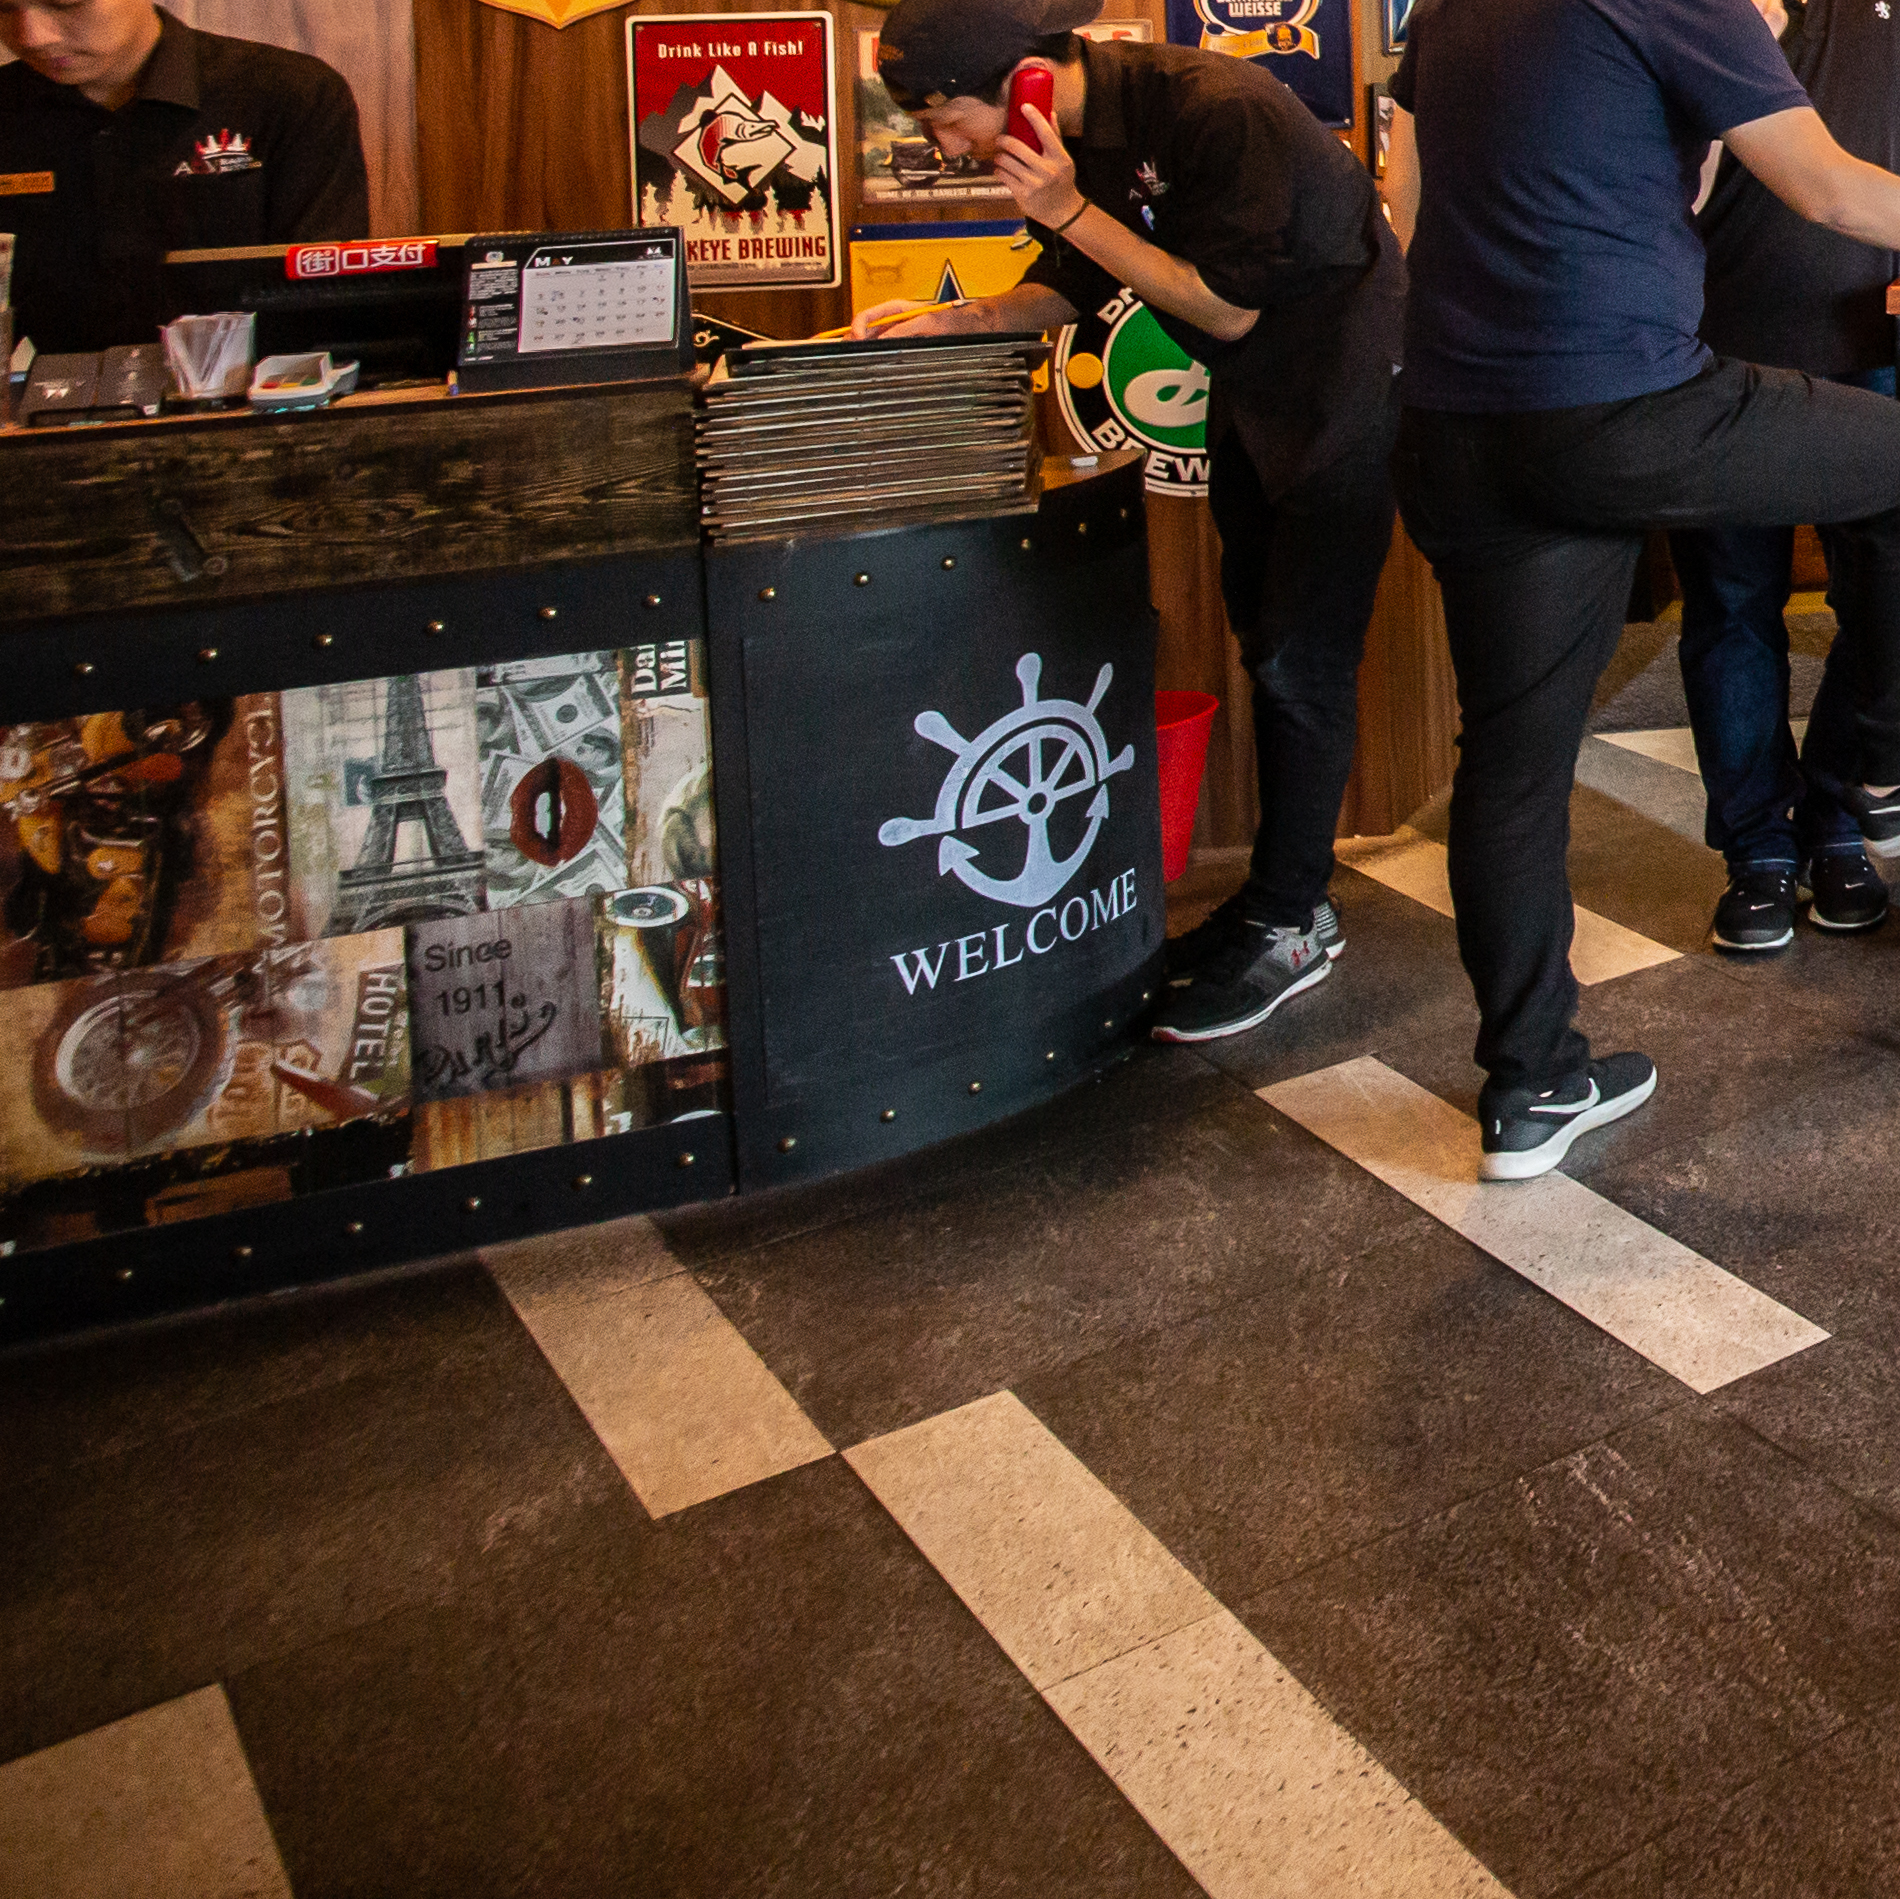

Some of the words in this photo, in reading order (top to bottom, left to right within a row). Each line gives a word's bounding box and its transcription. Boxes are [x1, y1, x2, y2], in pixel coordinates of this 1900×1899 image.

[1228, 0, 1282, 17] WEISSE
[657, 42, 702, 59] Drink
[708, 42, 742, 58] Like
[748, 41, 758, 56] A
[763, 40, 804, 56] Fish!
[297, 243, 427, 276] 街口支付
[534, 256, 574, 268] MAY
[687, 239, 731, 262] KEYE
[737, 235, 827, 260] BREWING
[890, 866, 1139, 996] WELCOME
[424, 938, 513, 972] Since
[349, 972, 398, 1079] HOTEL
